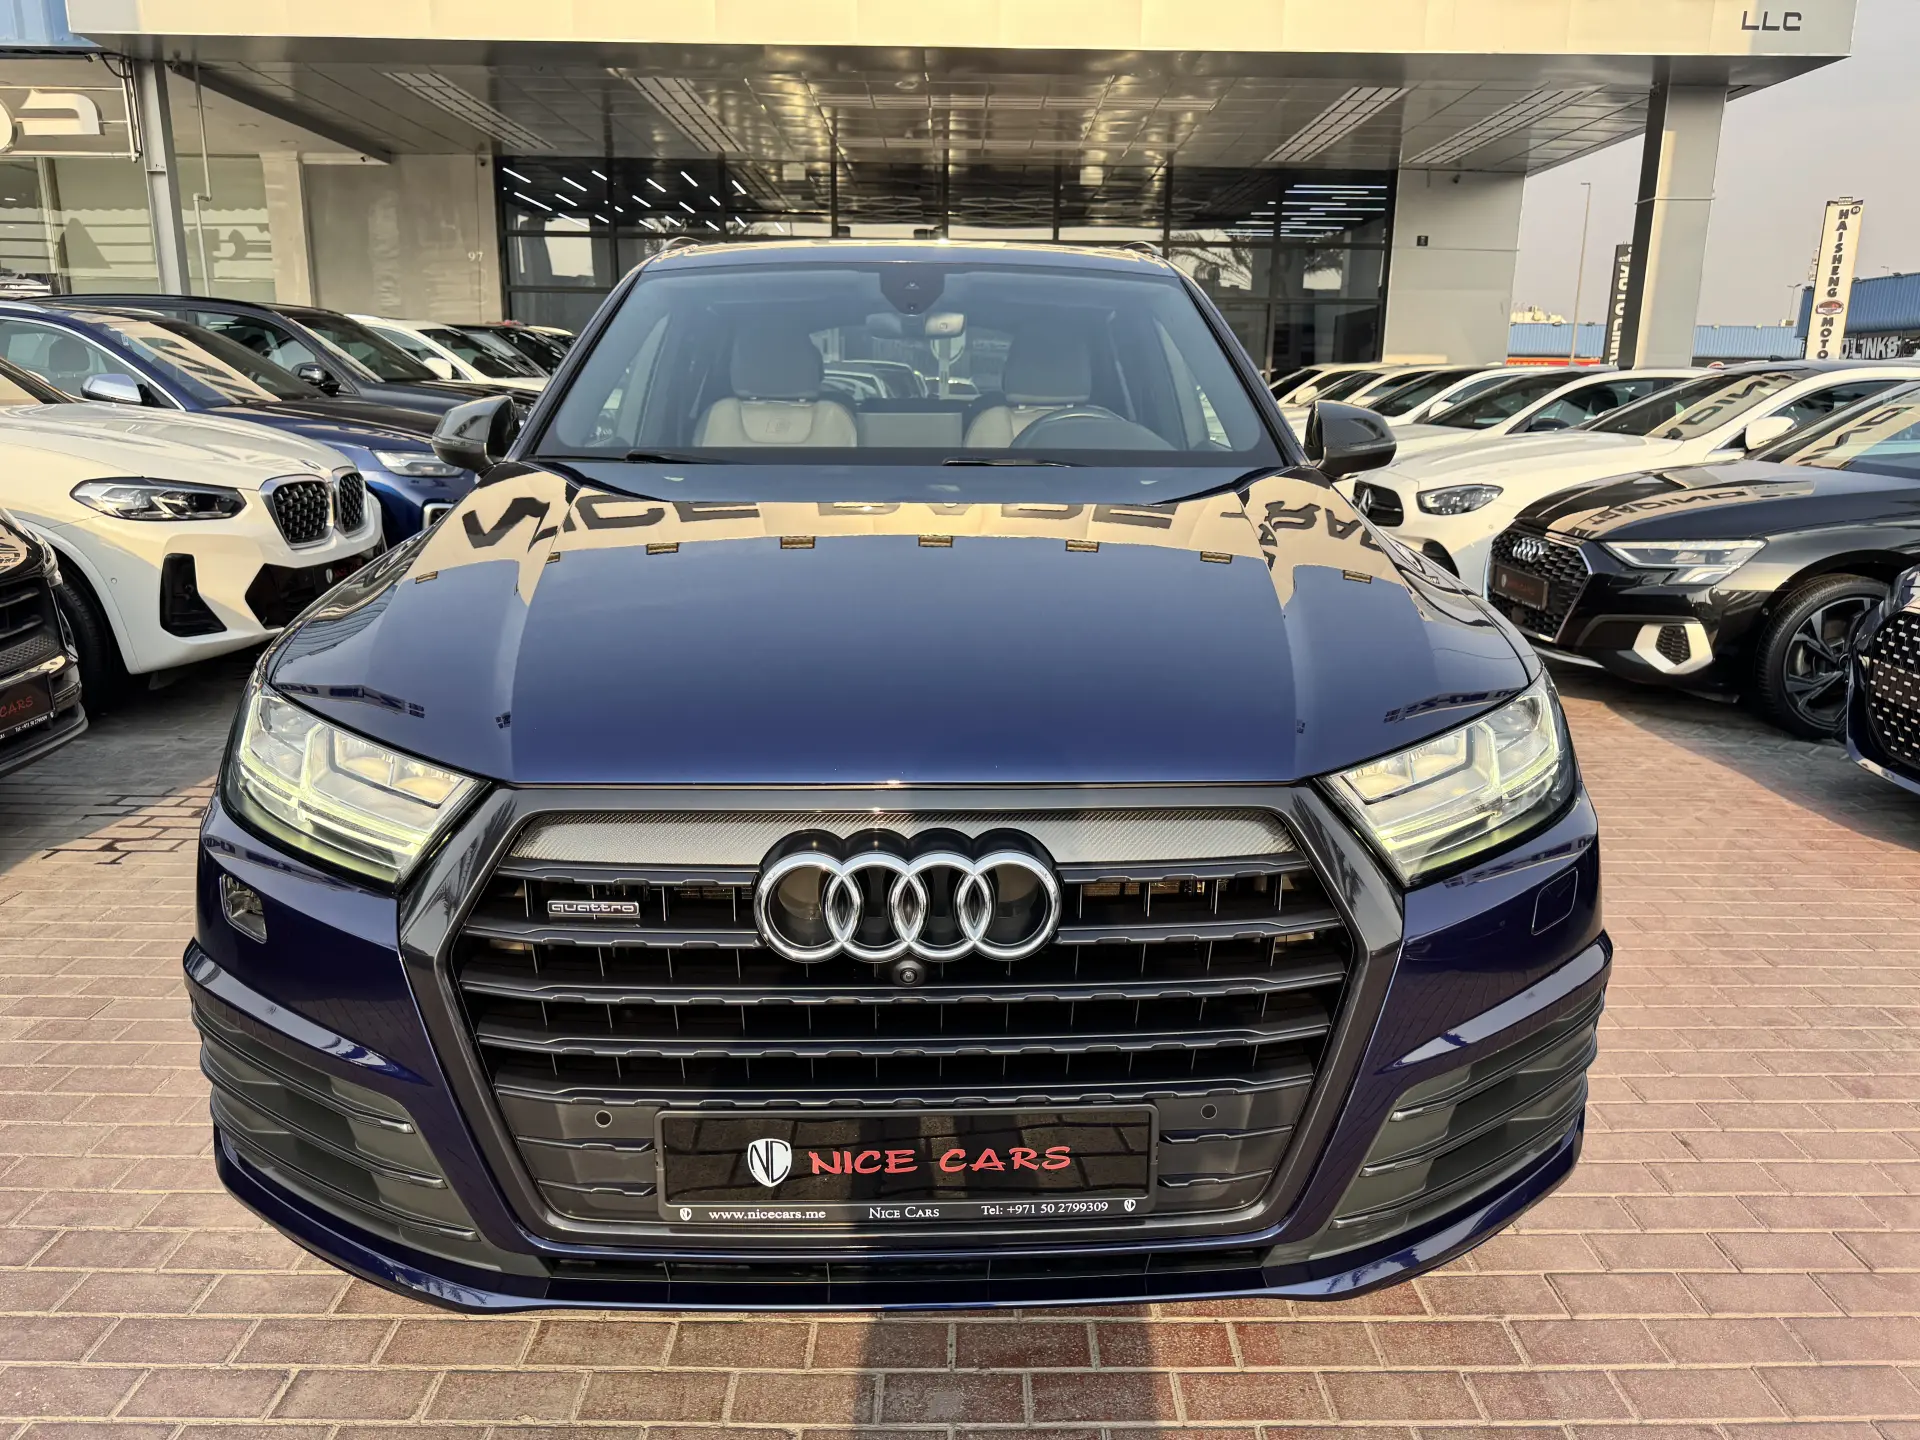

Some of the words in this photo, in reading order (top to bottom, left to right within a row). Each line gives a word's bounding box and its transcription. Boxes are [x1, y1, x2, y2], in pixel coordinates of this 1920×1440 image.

[1741, 10, 1802, 31] LLC
[468, 251, 484, 262] 97
[1827, 209, 1850, 298] HAISHENG
[551, 903, 635, 913] quattro
[808, 1149, 919, 1175] NICE
[939, 1145, 1072, 1173] CARS
[708, 1209, 826, 1220] www.nicecars.me
[981, 1204, 1003, 1216] Tel:
[1006, 1203, 1036, 1215] +971
[1040, 1202, 1055, 1214] 50
[1057, 1201, 1109, 1214] 2799309
